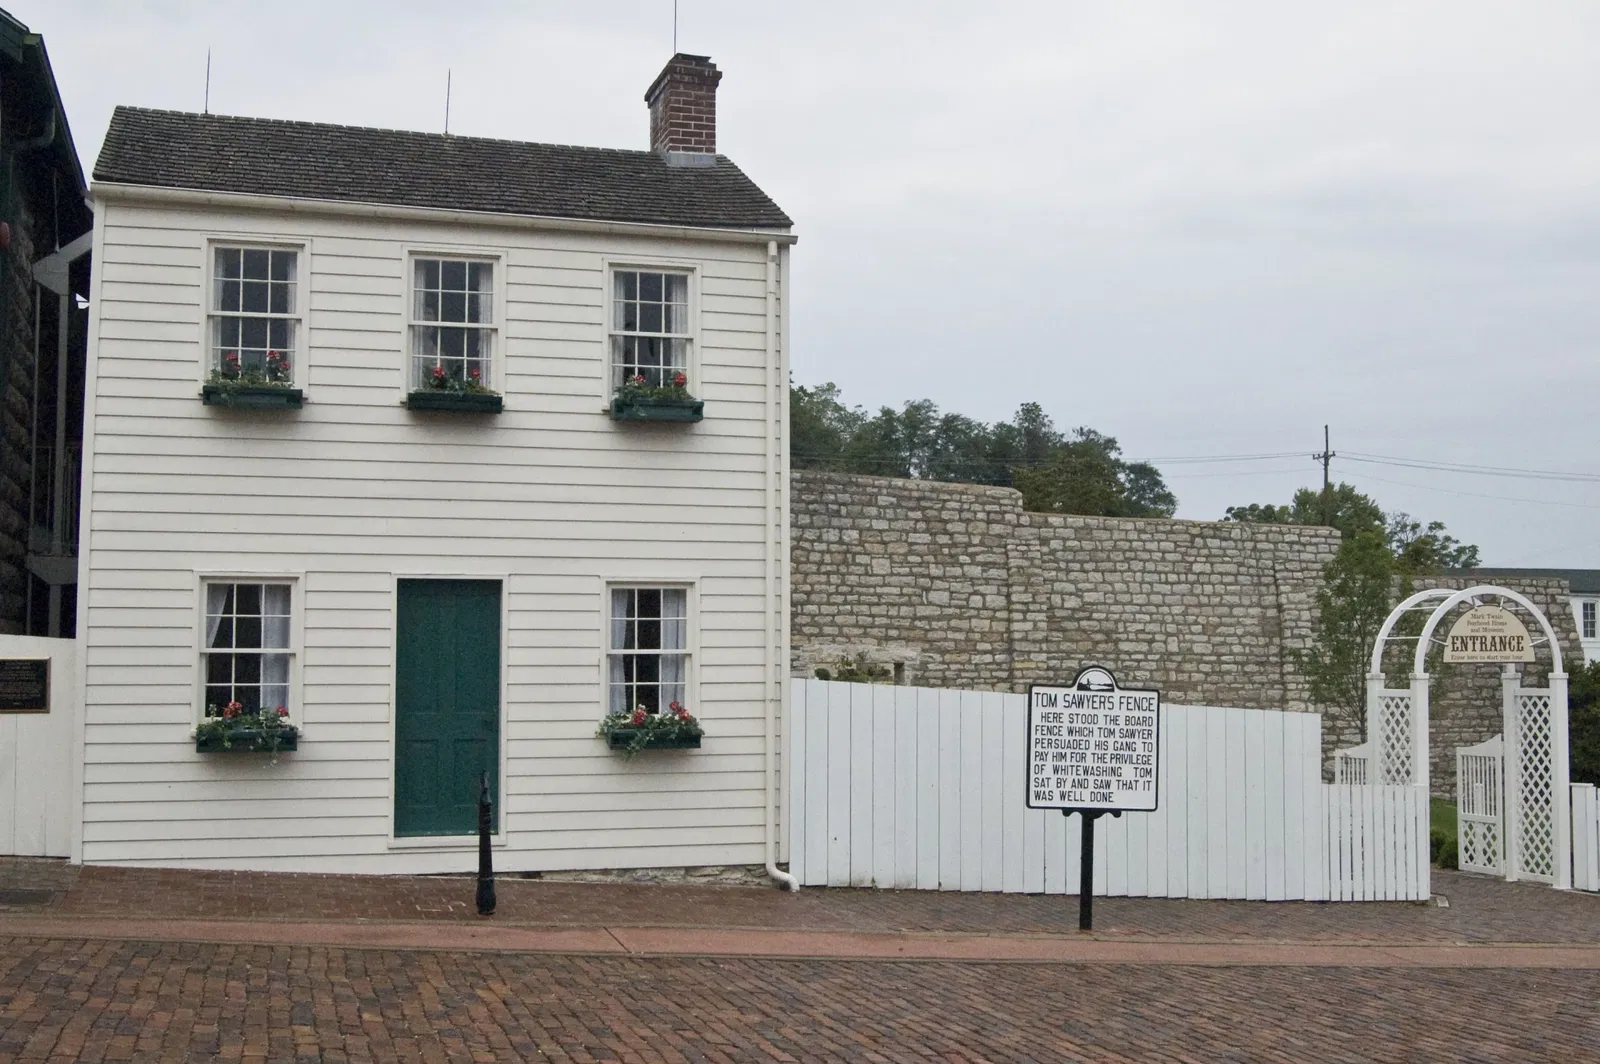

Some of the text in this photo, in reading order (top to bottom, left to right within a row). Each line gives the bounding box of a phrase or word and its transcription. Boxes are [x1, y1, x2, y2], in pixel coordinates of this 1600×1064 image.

[1451, 635, 1524, 652] ENTRANCE
[1034, 692, 1155, 712] TOM SAWYER'S FENCE
[1041, 712, 1153, 727] HERE STOOD THE BOARD
[1035, 725, 1153, 740] FENCE WHICH TOM SAWYER
[1035, 738, 1153, 752] PERSUADED HIS GANG TO
[1035, 751, 1152, 765] PAY HIM FOR THE PRIVILEGE
[1034, 764, 1152, 778] OF WHITEWASHING TOM
[1034, 777, 1152, 791] SAT BY AND SAW THAT IT
[1034, 790, 1053, 801] WAS
[1059, 791, 1085, 802] WELL
